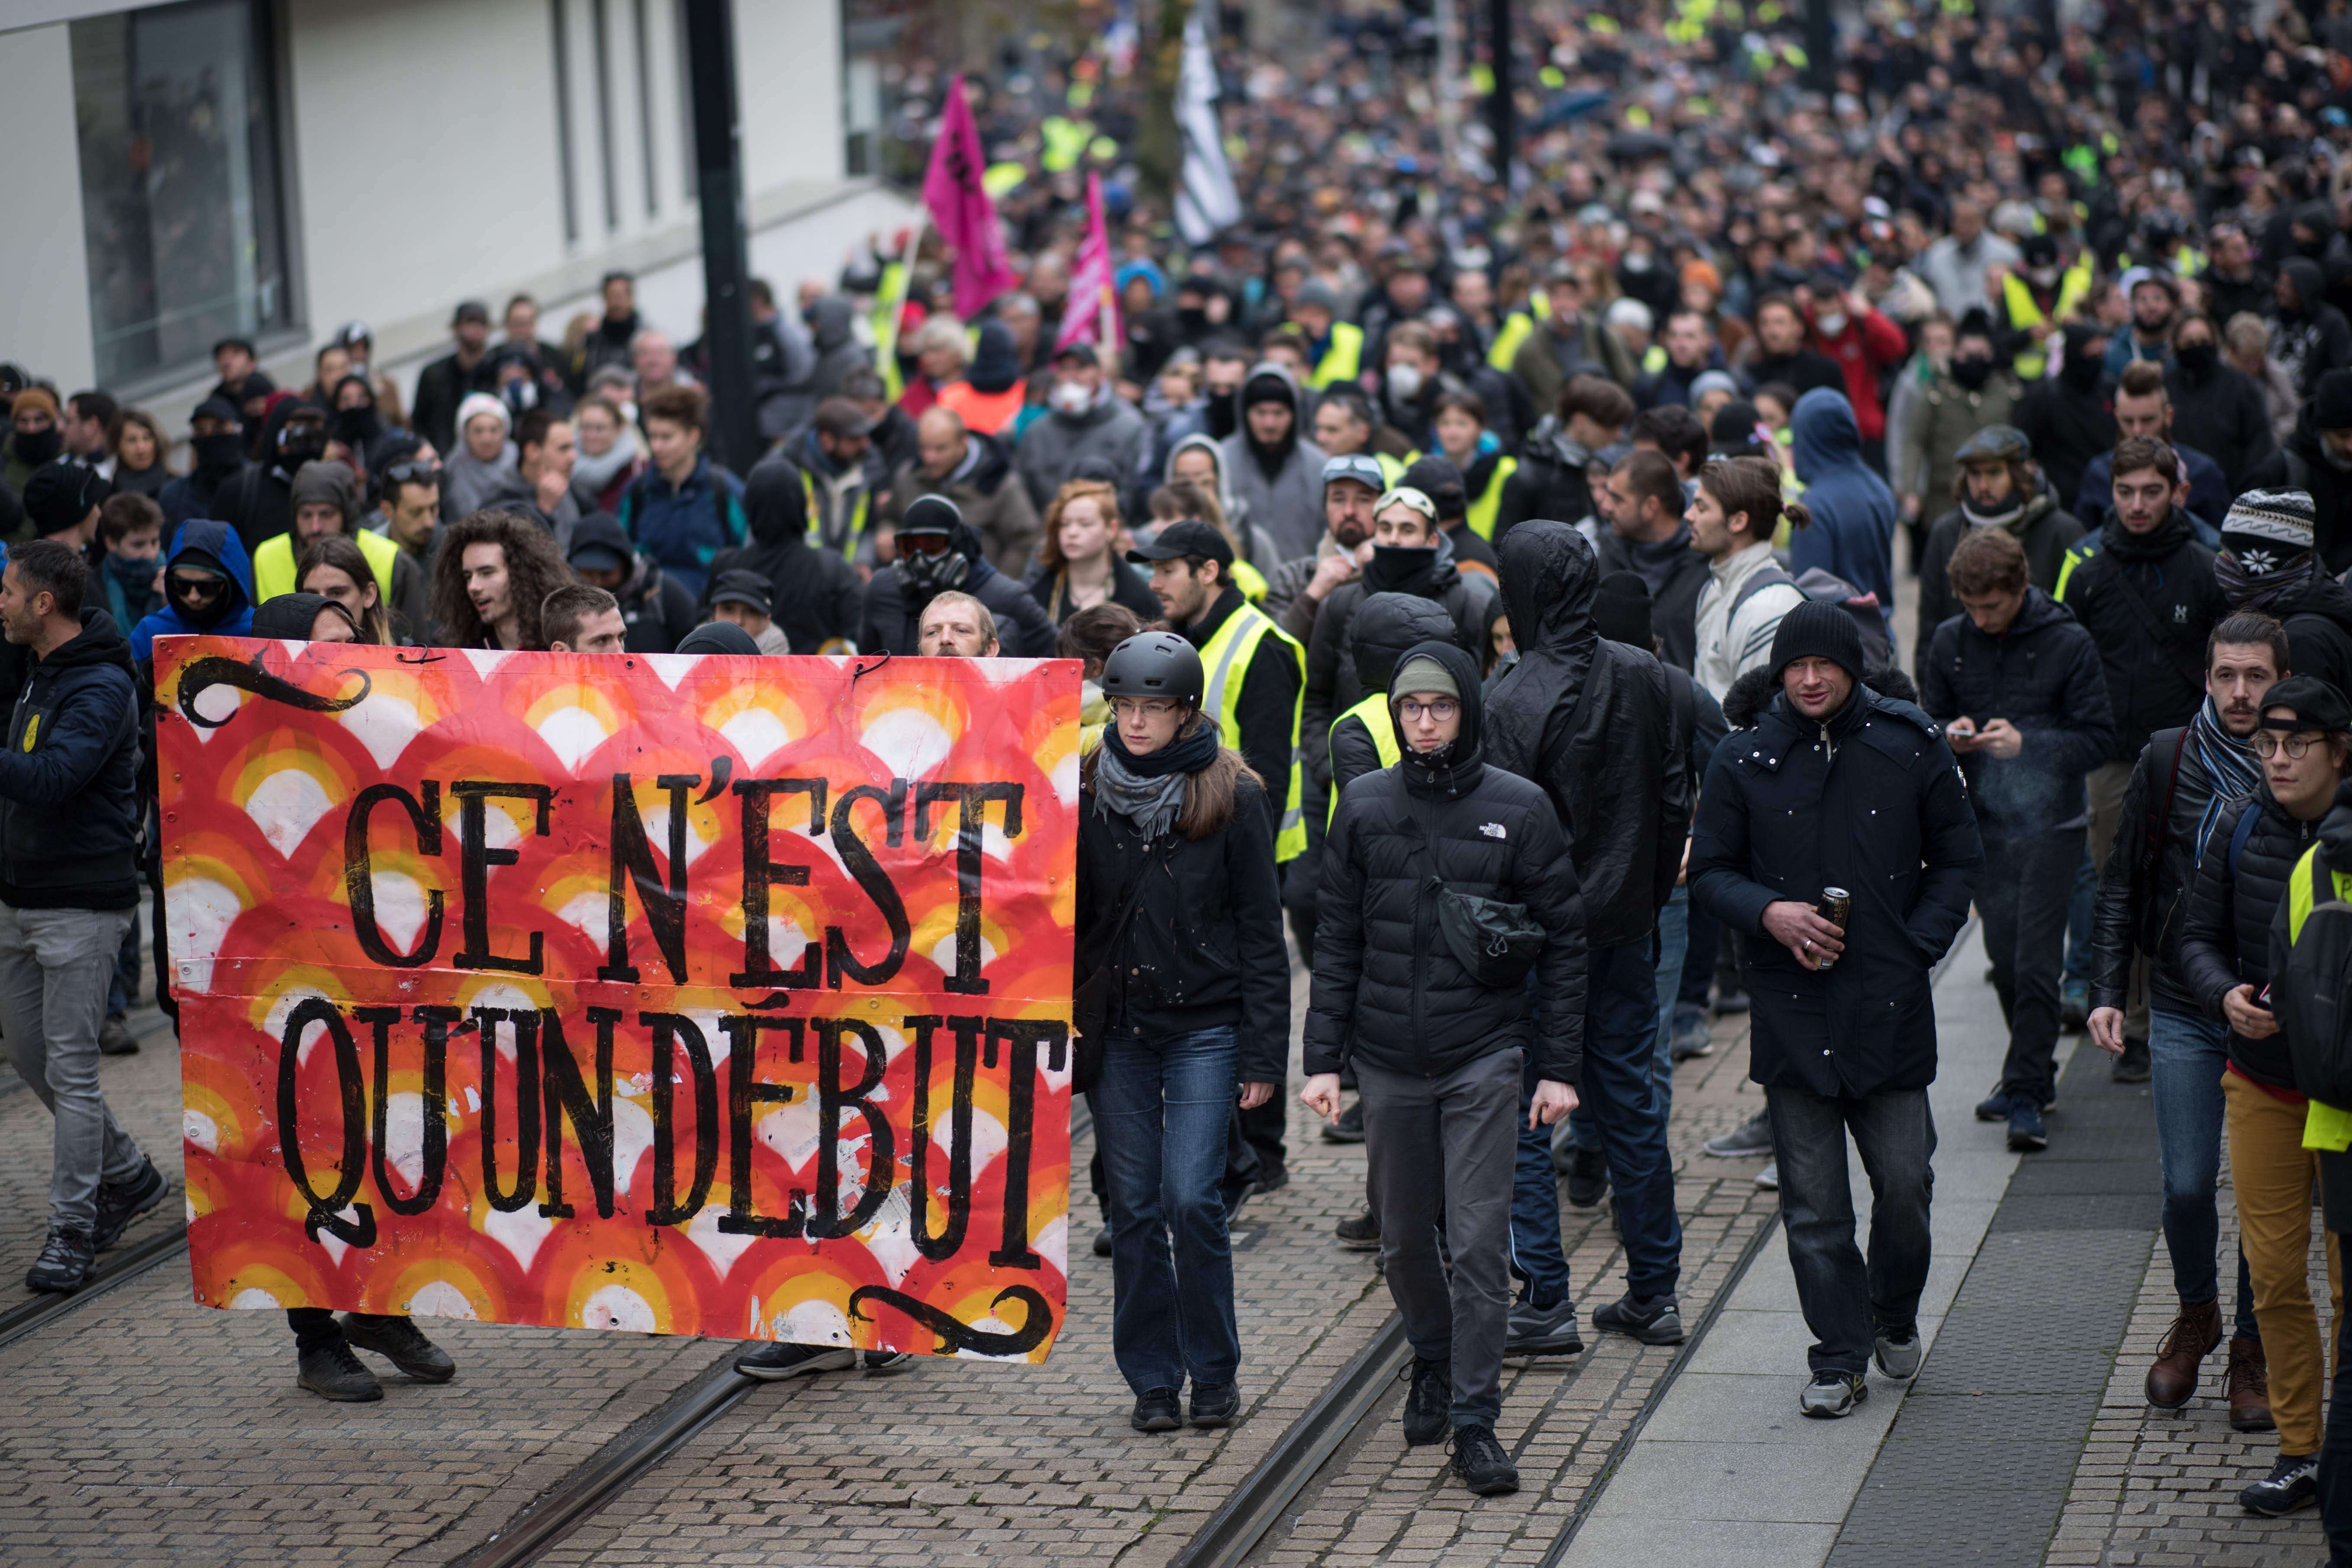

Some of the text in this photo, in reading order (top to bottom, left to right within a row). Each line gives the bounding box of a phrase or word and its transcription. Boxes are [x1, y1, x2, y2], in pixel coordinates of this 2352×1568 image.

[344, 756, 1023, 994] CE N'EST
[641, 991, 1070, 1269] DÉBUT
